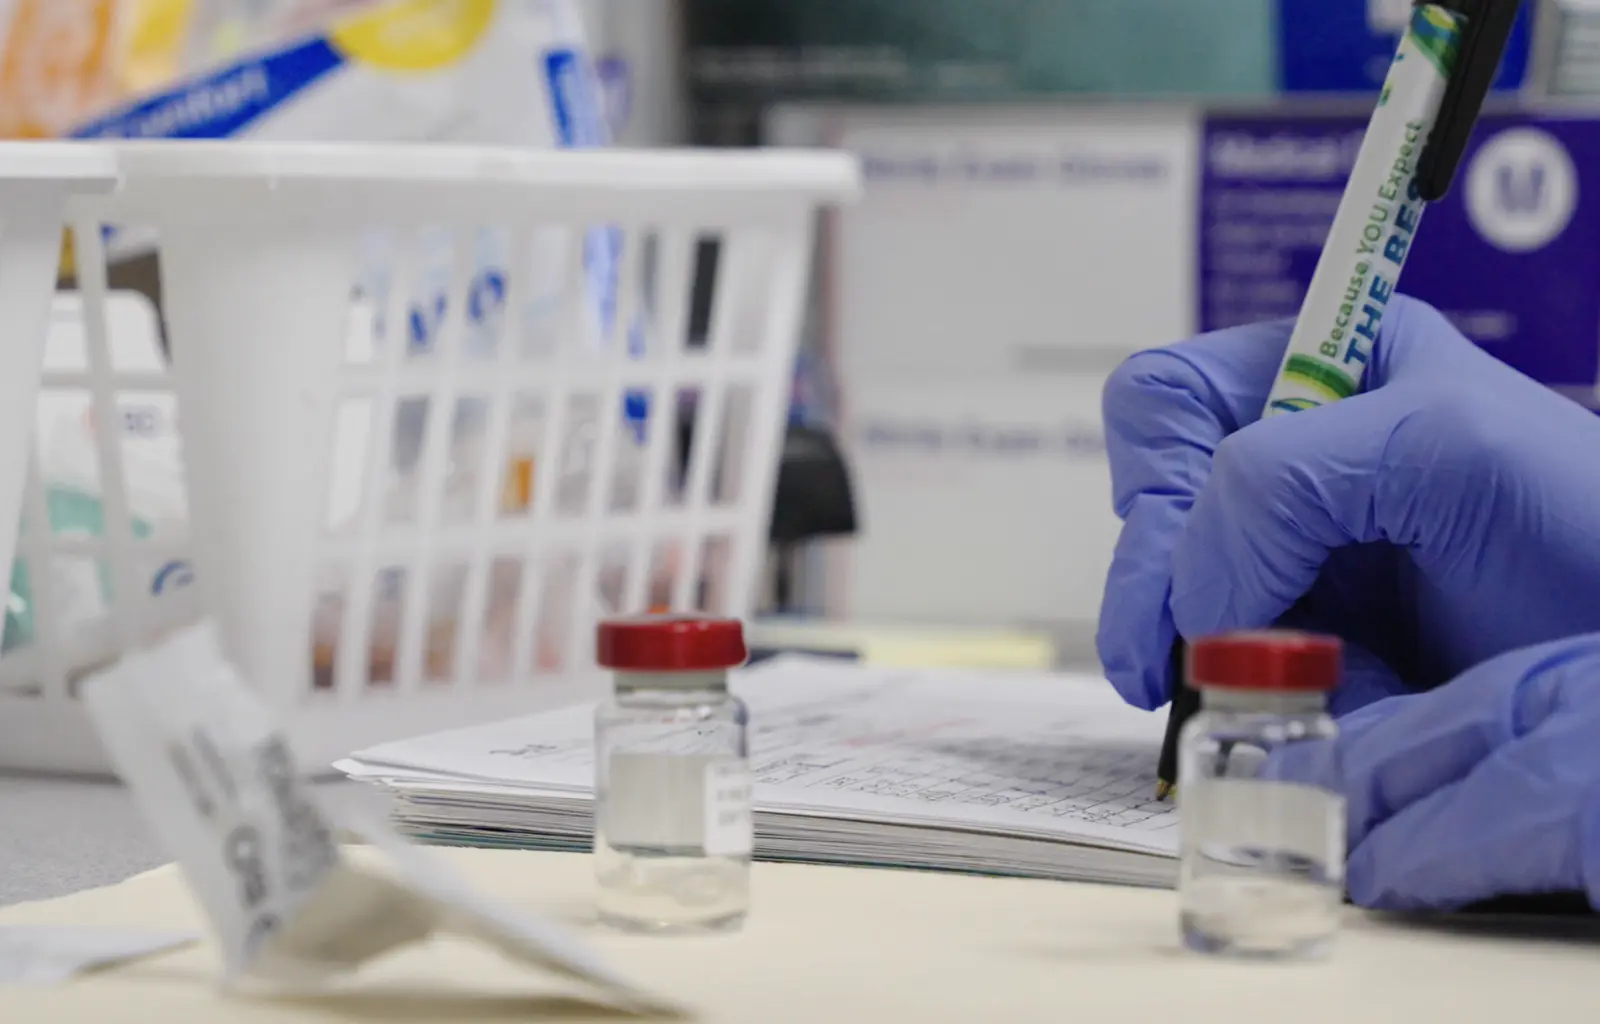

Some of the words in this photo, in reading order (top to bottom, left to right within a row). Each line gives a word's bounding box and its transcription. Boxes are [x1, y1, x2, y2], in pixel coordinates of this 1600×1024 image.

[1320, 261, 1369, 358] Because
[1356, 204, 1389, 254] YOU
[1378, 120, 1422, 201] Expect
[1343, 274, 1393, 365] THE
